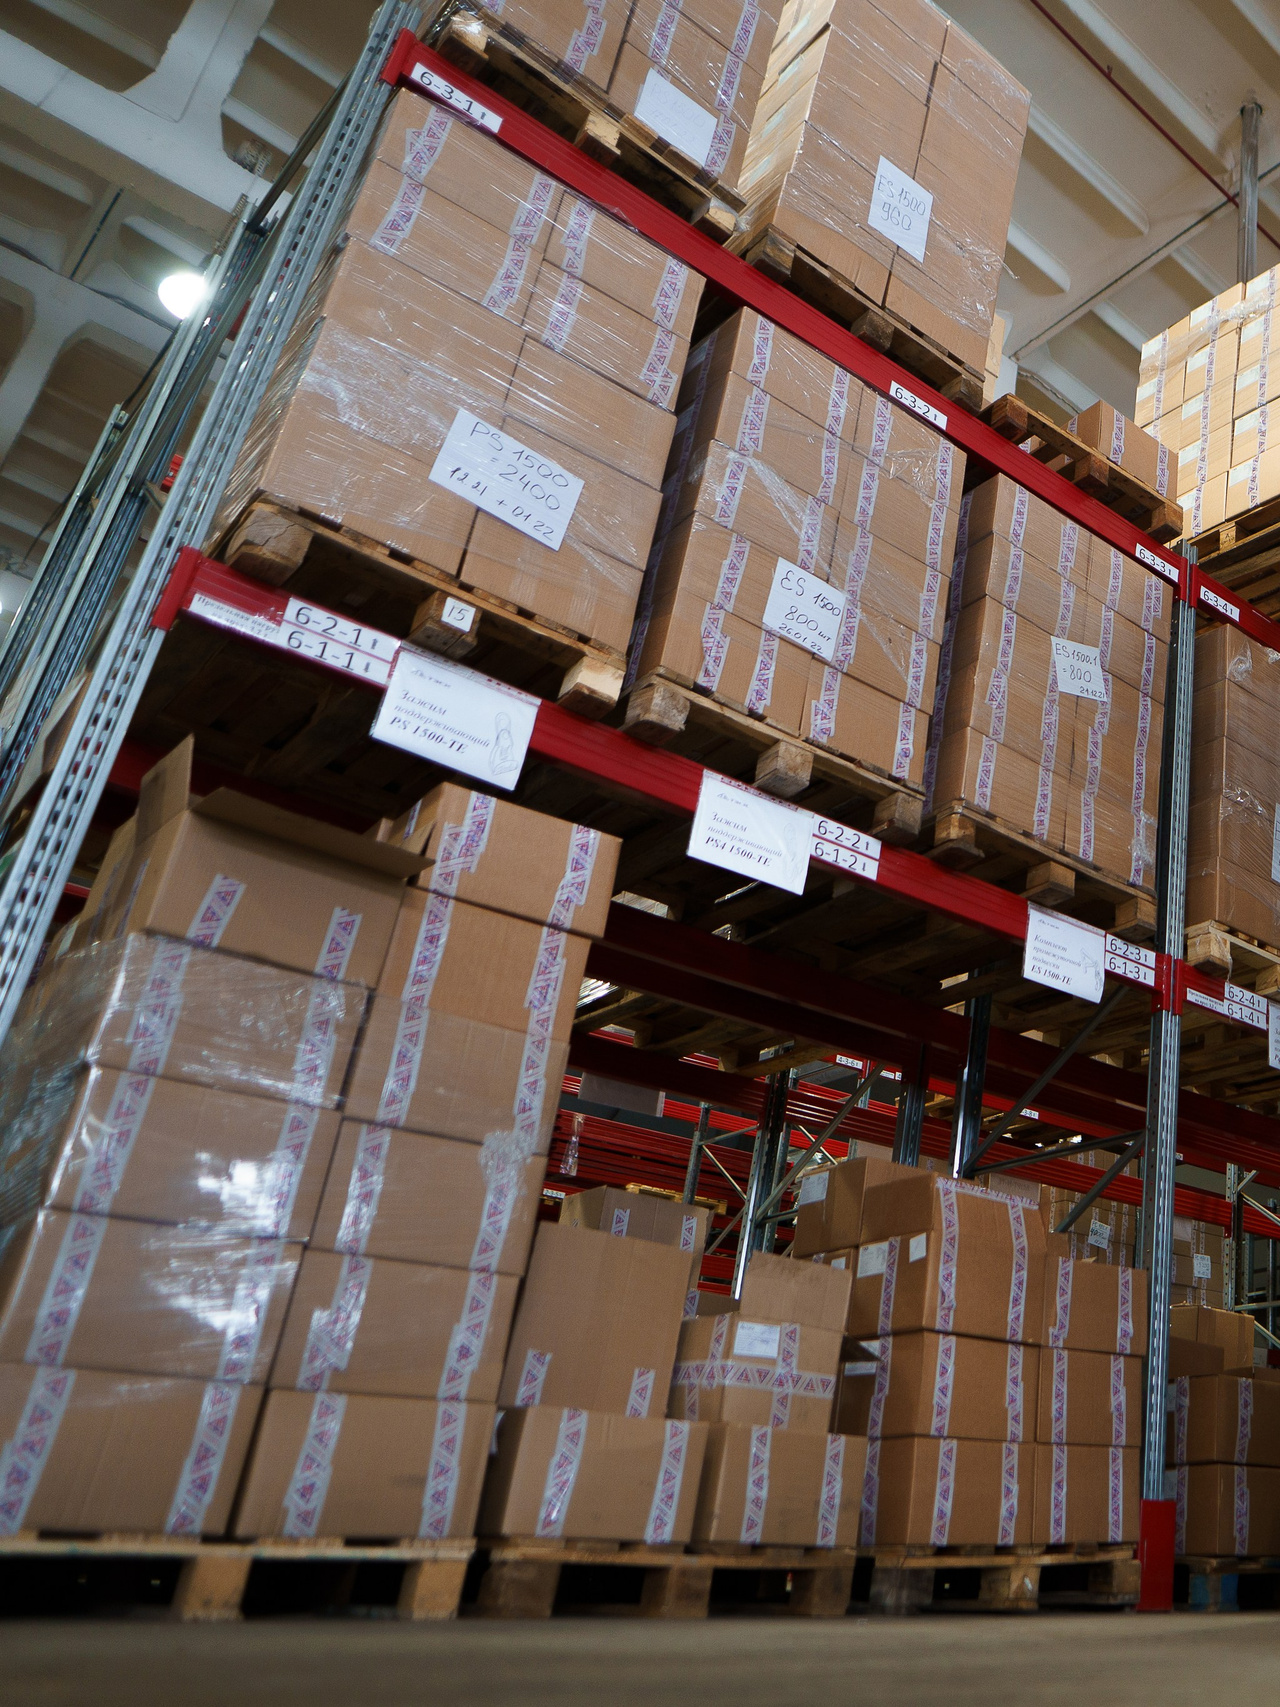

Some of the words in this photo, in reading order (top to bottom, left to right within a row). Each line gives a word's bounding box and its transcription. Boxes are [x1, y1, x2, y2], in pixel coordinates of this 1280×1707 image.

[419, 71, 474, 116] 6-3-1
[877, 174, 894, 199] ES
[898, 187, 926, 216] 1500
[880, 201, 912, 231] 960
[894, 386, 931, 419] 6-3-2
[470, 421, 504, 452] PS
[512, 449, 569, 488] 1500
[1139, 548, 1167, 573] 6-3-3
[780, 569, 806, 597] ES
[813, 592, 842, 617] 1500
[1203, 590, 1228, 614] 6-3-4
[294, 605, 363, 648] 6-2-1
[447, 604, 470, 622] 15
[784, 605, 819, 632] 800
[286, 629, 356, 672] 6-1-1
[1055, 642, 1070, 658] ES
[1071, 649, 1098, 667] 1500.1
[400, 689, 447, 717] Зажим
[389, 715, 408, 731] PS
[411, 724, 470, 755] 1500-TE
[711, 811, 748, 833] Зажим
[817, 819, 861, 850] 6-2-2
[728, 843, 771, 867] 1500-TE
[814, 841, 858, 871] 6-1-2
[1110, 937, 1141, 962] 6-2-3
[1031, 964, 1042, 976] ES
[1108, 956, 1141, 980] 6-1-3
[1228, 985, 1256, 1008] 6-2-4
[1227, 1003, 1255, 1024] 6-1-4
